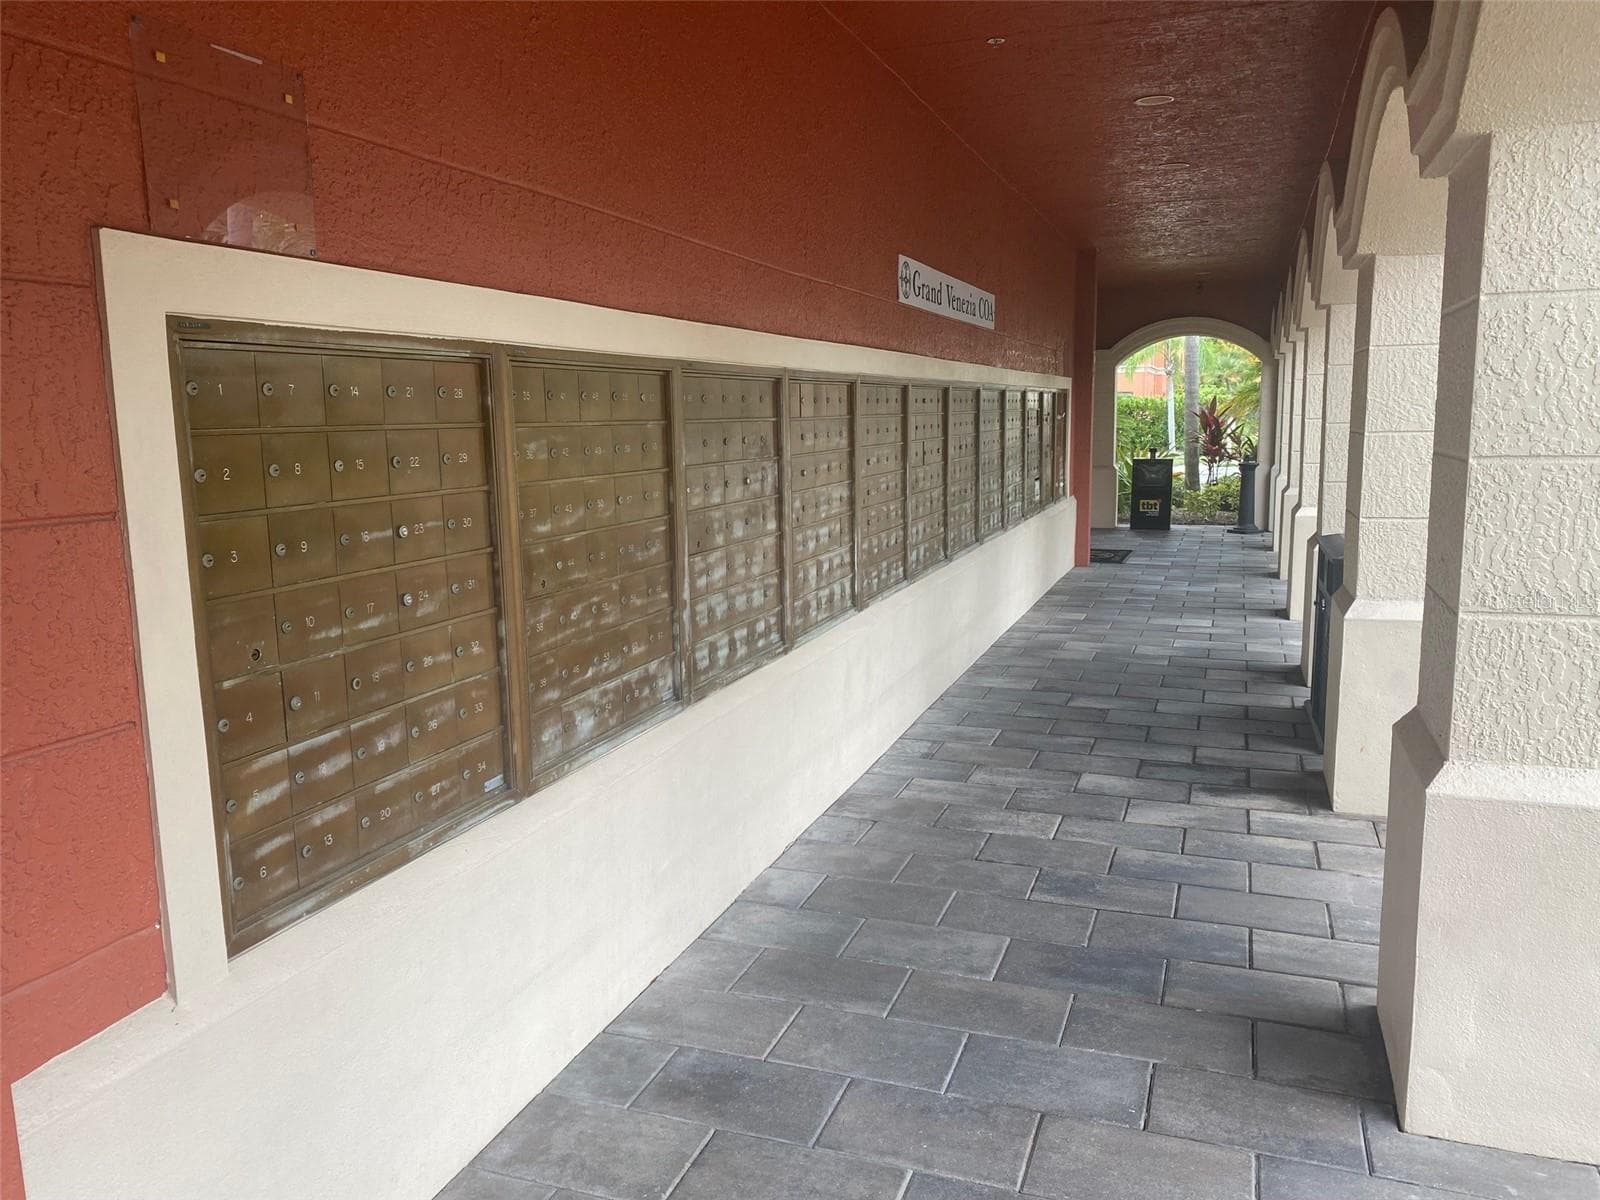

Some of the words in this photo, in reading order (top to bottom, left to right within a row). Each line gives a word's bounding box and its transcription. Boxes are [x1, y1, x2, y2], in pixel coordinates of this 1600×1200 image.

[913, 270, 942, 305] Grand
[946, 284, 976, 317] Venezia
[978, 297, 993, 322] COA
[217, 384, 223, 396] 1
[288, 385, 295, 396] 7
[350, 386, 359, 397] 14
[406, 387, 414, 398] 21
[454, 388, 464, 399] 28
[410, 457, 420, 467] 22
[458, 453, 468, 463] 29
[294, 463, 302, 475] 8
[355, 459, 364, 470] 15
[223, 468, 230, 480] 2
[1141, 501, 1158, 510] tbt
[462, 517, 472, 527] 30
[414, 523, 424, 534] 23
[361, 531, 369, 542] 16
[300, 540, 308, 553] 9
[230, 550, 238, 563] 3
[418, 591, 429, 601] 24
[367, 602, 375, 614] 17
[305, 616, 315, 627] 10
[314, 691, 321, 702] 11
[246, 712, 253, 723] 4
[428, 719, 438, 731] 26
[477, 761, 486, 773] 34
[380, 807, 391, 820] 20
[260, 866, 267, 877] 6
